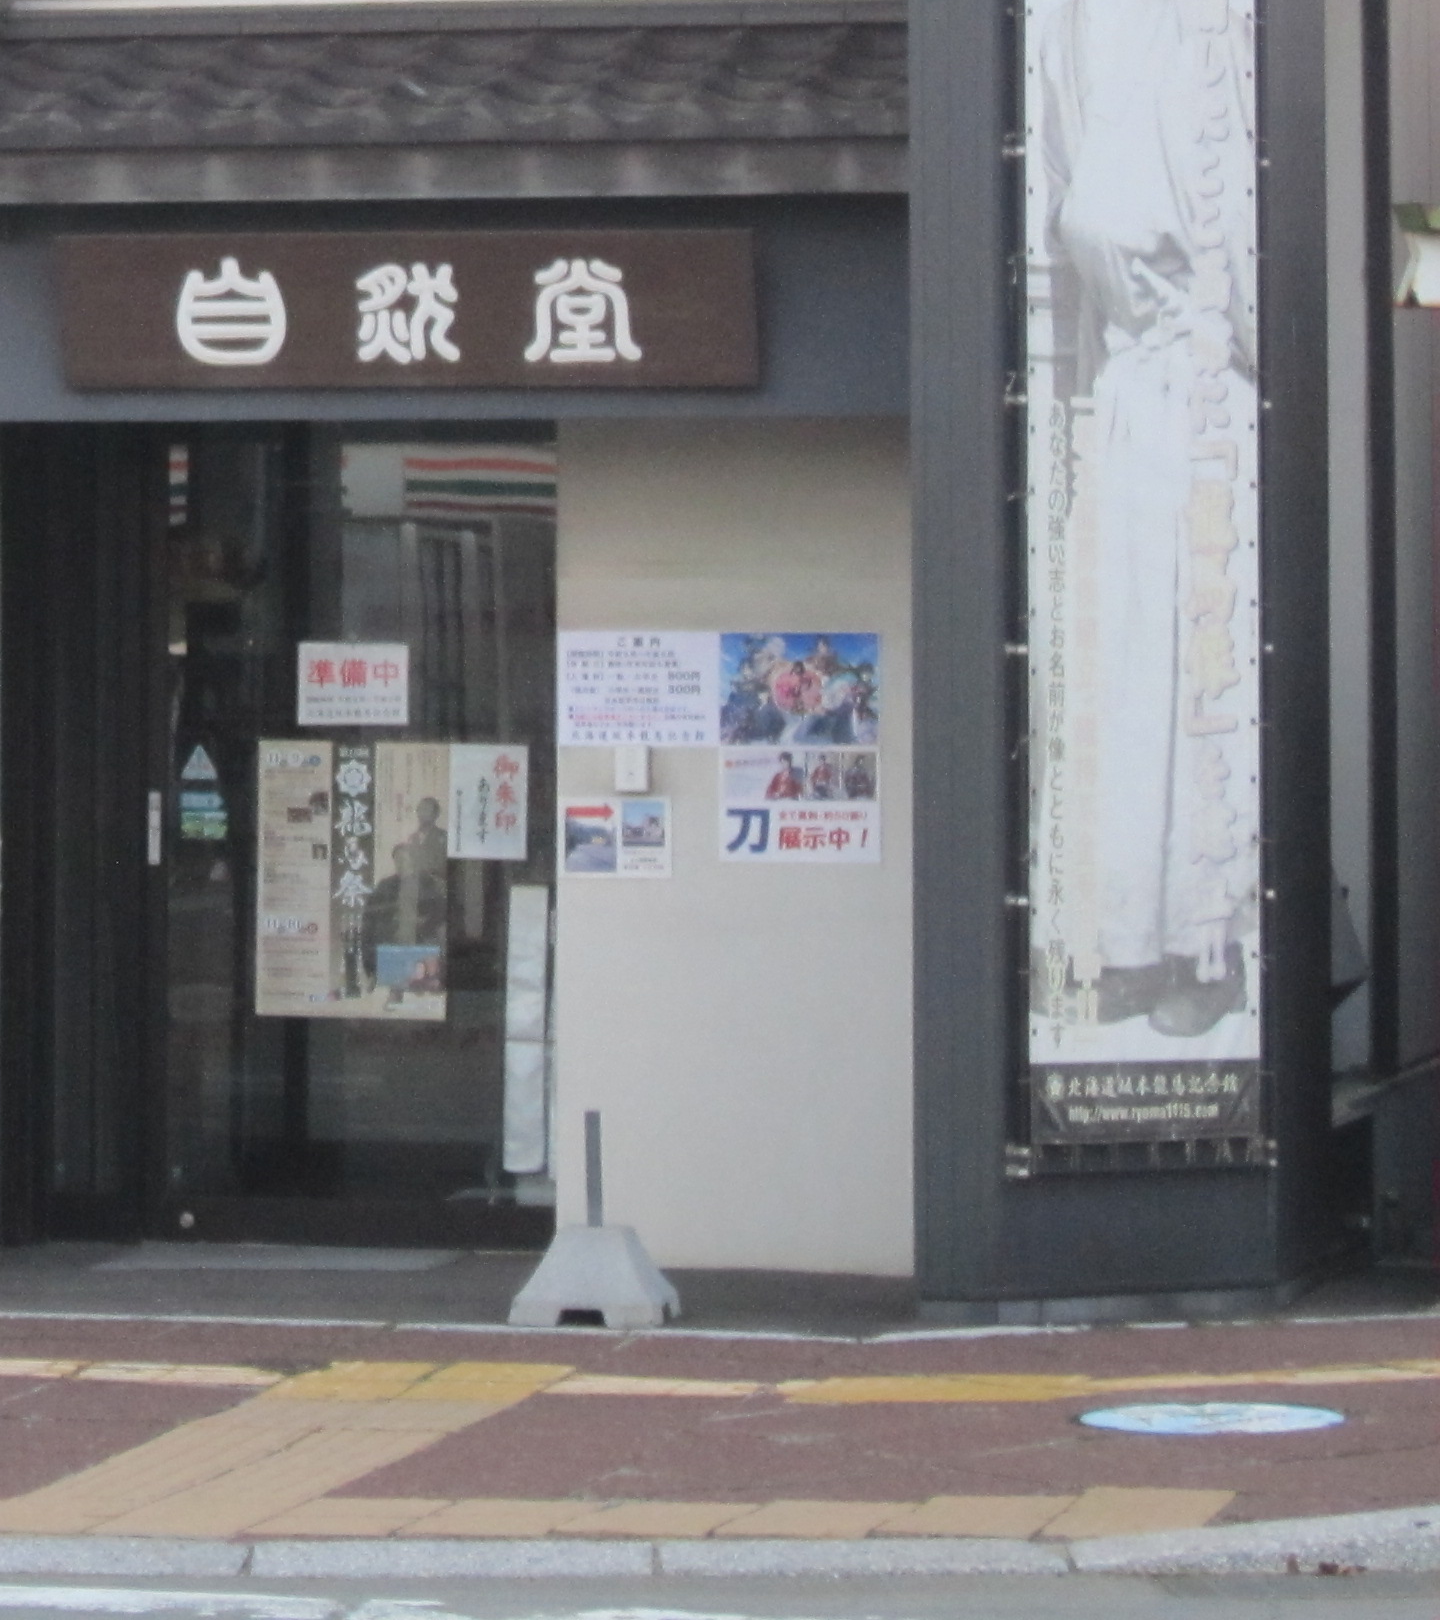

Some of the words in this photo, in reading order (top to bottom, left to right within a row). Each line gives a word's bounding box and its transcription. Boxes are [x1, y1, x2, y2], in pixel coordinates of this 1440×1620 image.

[176, 256, 642, 366] 自然堂
[307, 659, 399, 688] 準備中
[726, 808, 770, 853] 刀
